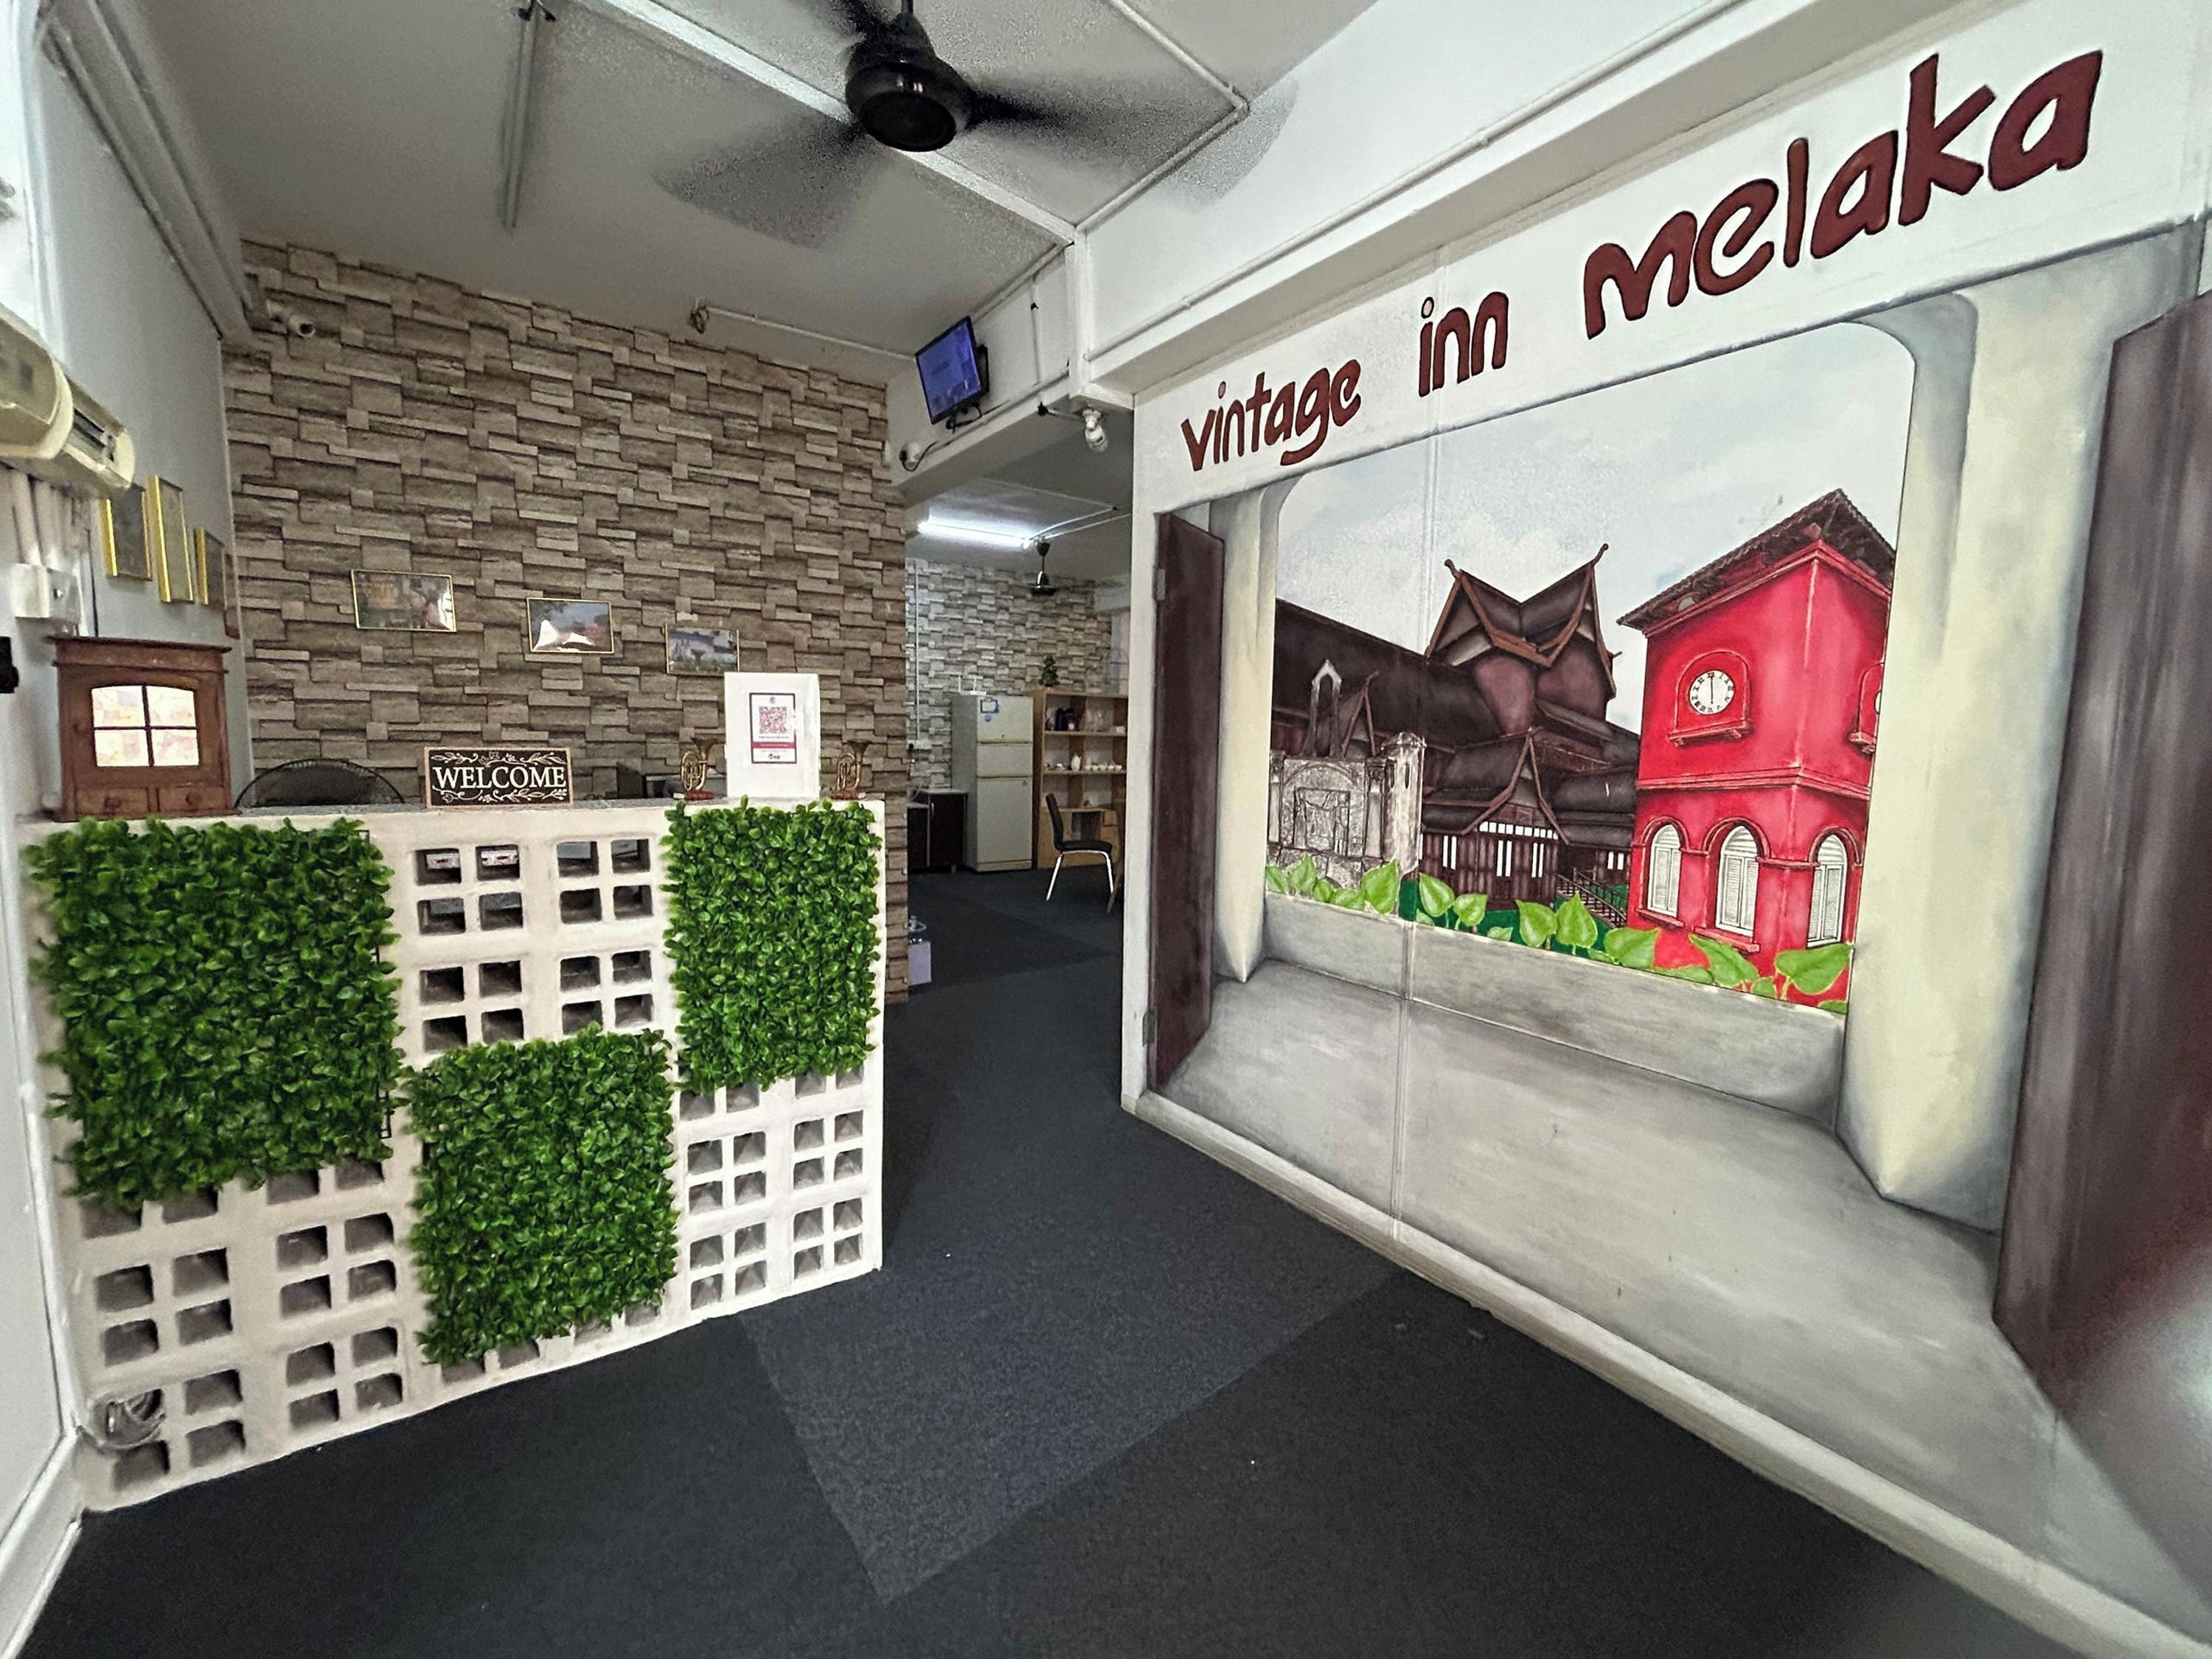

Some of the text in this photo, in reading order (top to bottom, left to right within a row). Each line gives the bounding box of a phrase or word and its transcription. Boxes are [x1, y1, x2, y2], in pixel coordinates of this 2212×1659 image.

[1180, 49, 2103, 472] vintage inn melaka
[432, 766, 566, 789] WELCOME
